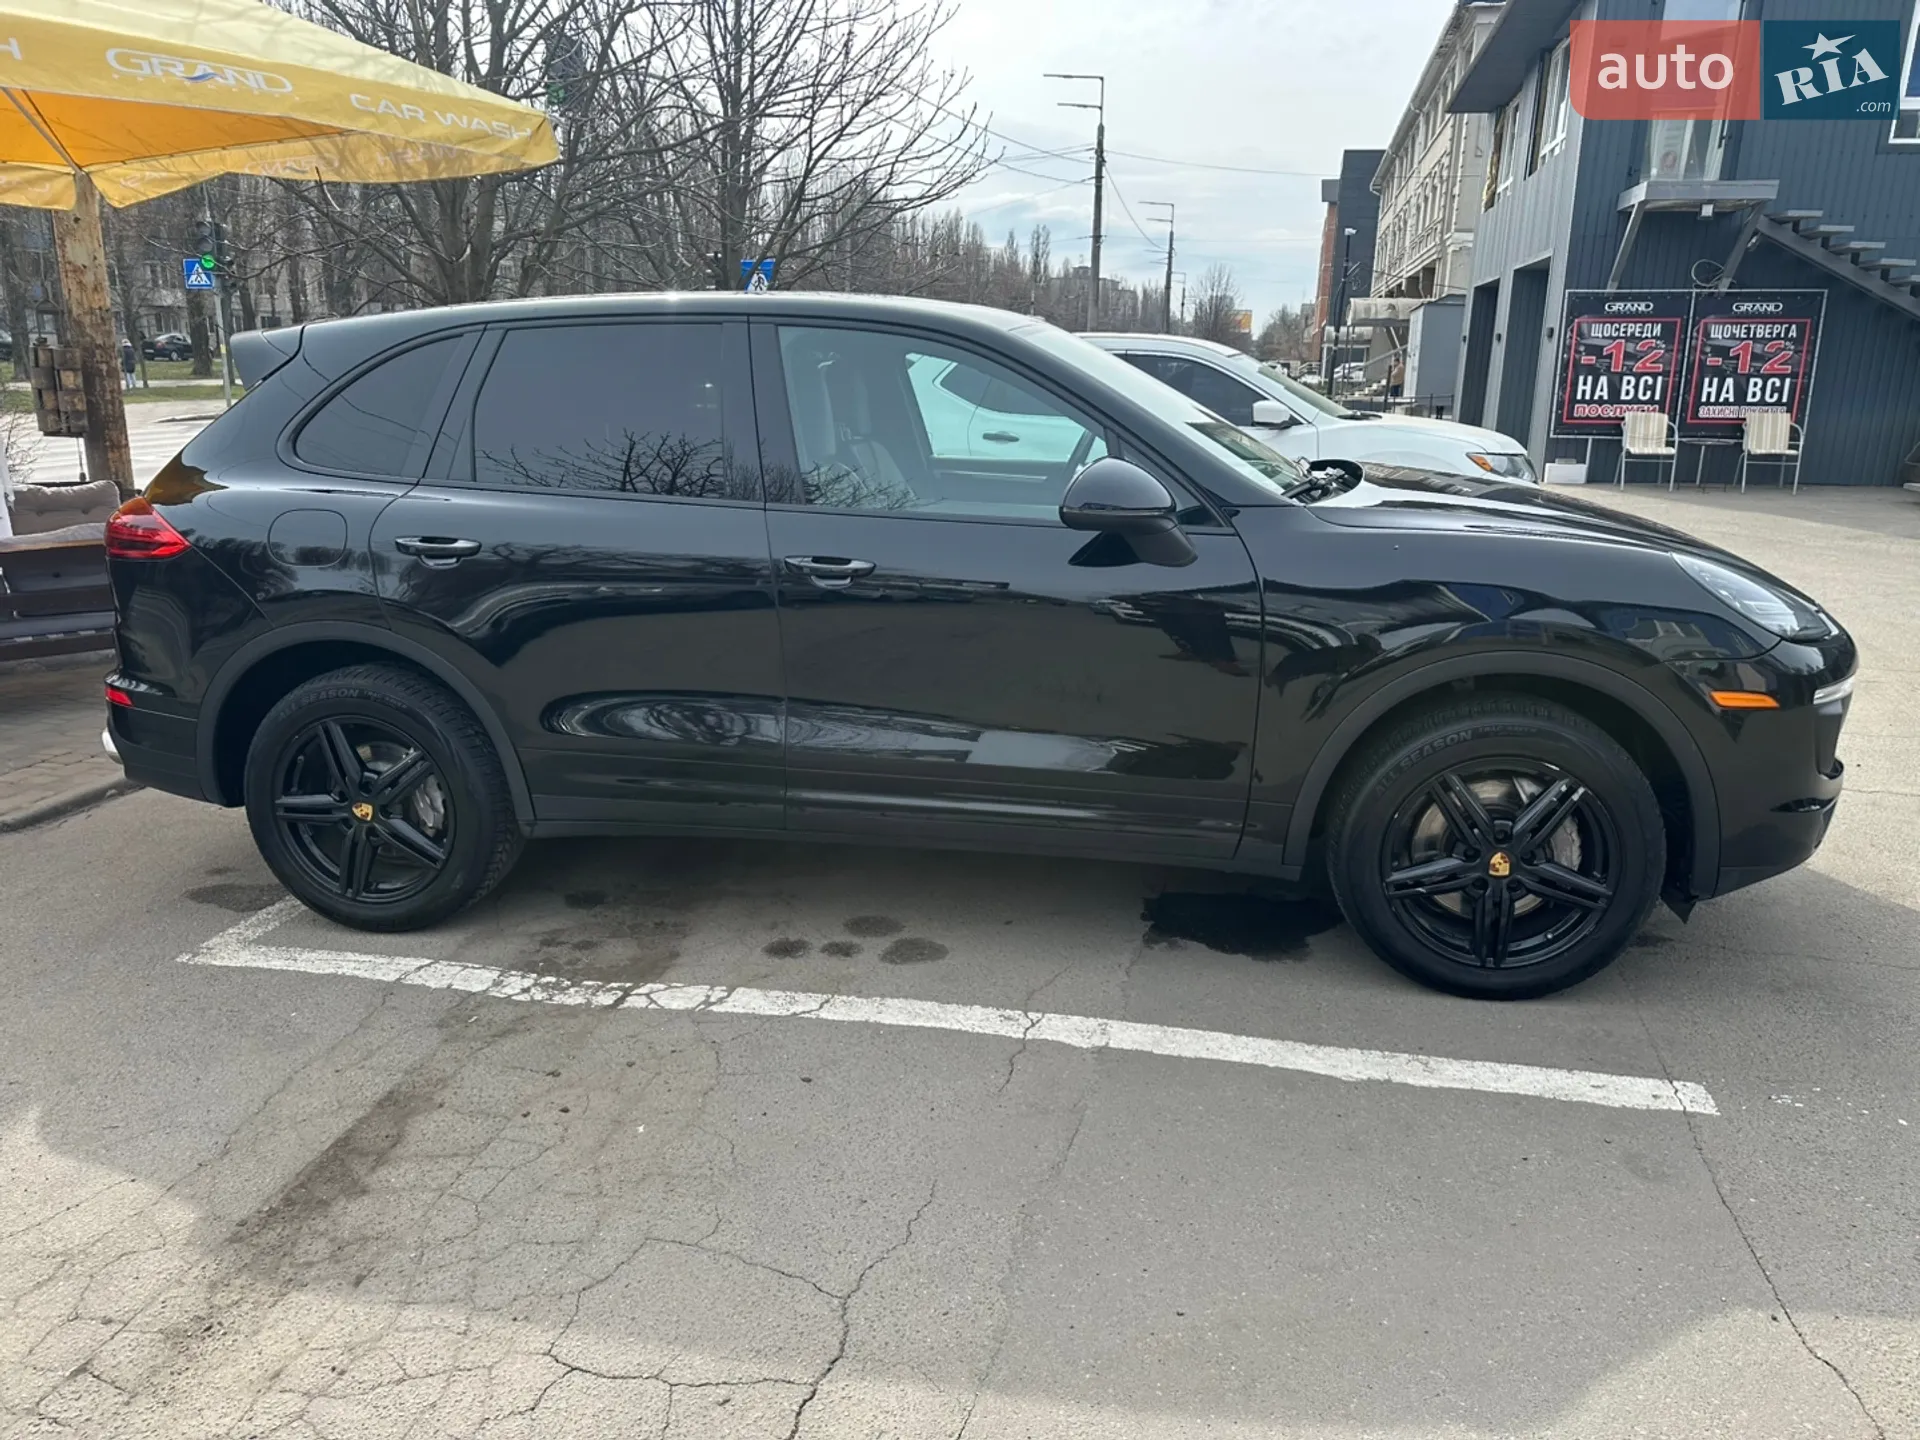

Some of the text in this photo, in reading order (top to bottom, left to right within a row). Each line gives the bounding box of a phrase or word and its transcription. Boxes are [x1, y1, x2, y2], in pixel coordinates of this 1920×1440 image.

[105, 48, 293, 93] GRAND
[351, 93, 532, 140] CAR WASH
[1604, 302, 1654, 312] GRAND
[1732, 302, 1783, 312] GRAND
[1590, 323, 1662, 338] ЩОСЕРЕДИ
[1710, 324, 1797, 339] ЩОЧЕТВЕРГА
[1576, 375, 1663, 400] НА ВСІ
[1701, 377, 1791, 403] НА ВСІ
[301, 688, 360, 704] SEASON
[1400, 729, 1473, 772] SEASON
